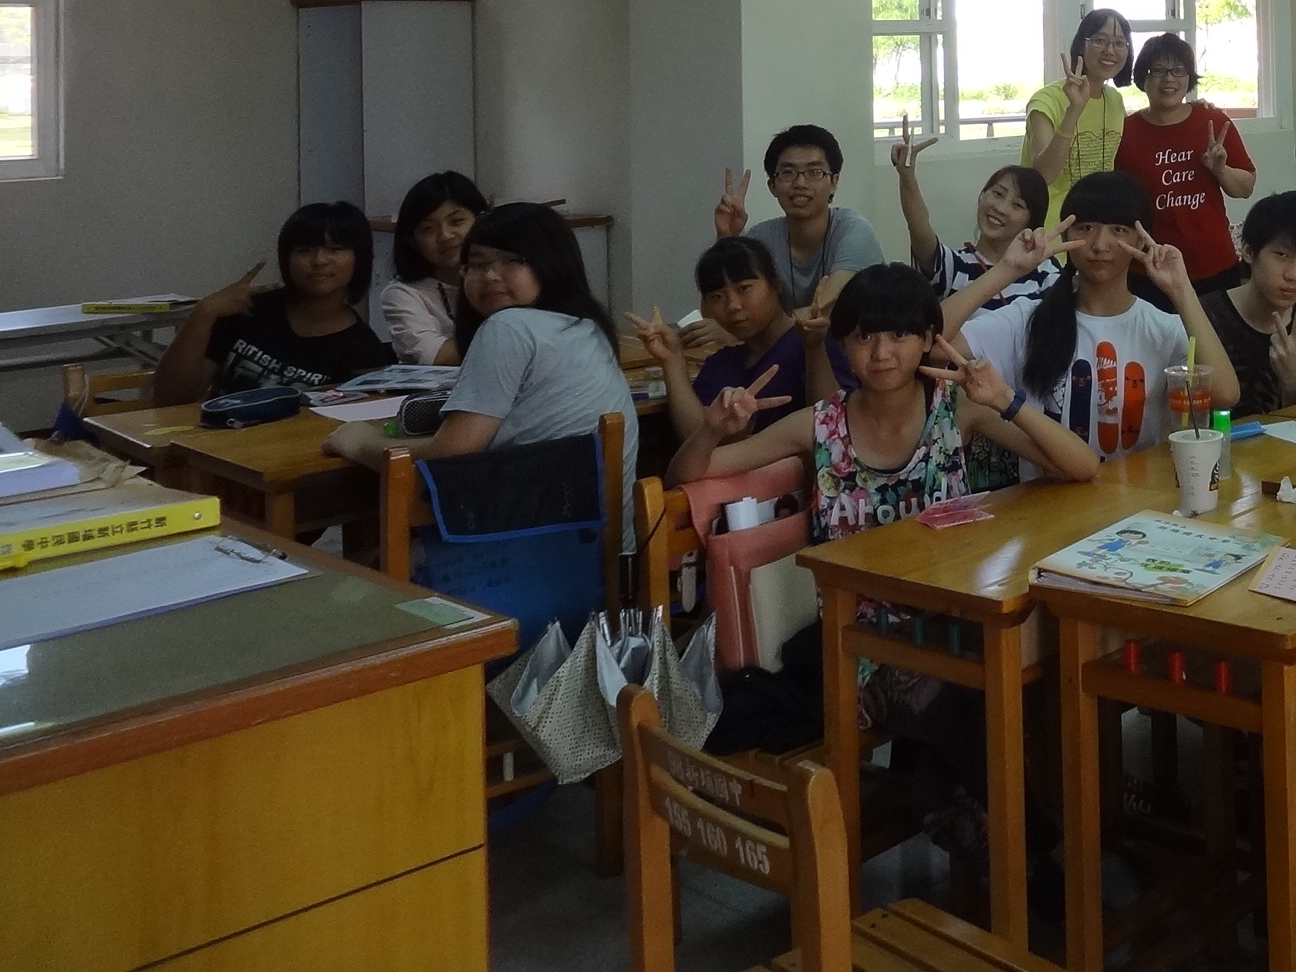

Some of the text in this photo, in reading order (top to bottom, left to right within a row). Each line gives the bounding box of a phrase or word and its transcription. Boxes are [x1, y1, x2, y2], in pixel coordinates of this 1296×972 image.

[1155, 149, 1194, 166] Hear
[1161, 169, 1195, 186] Care
[1155, 191, 1206, 210] Change
[697, 817, 728, 856] 160
[735, 835, 770, 875] 165
